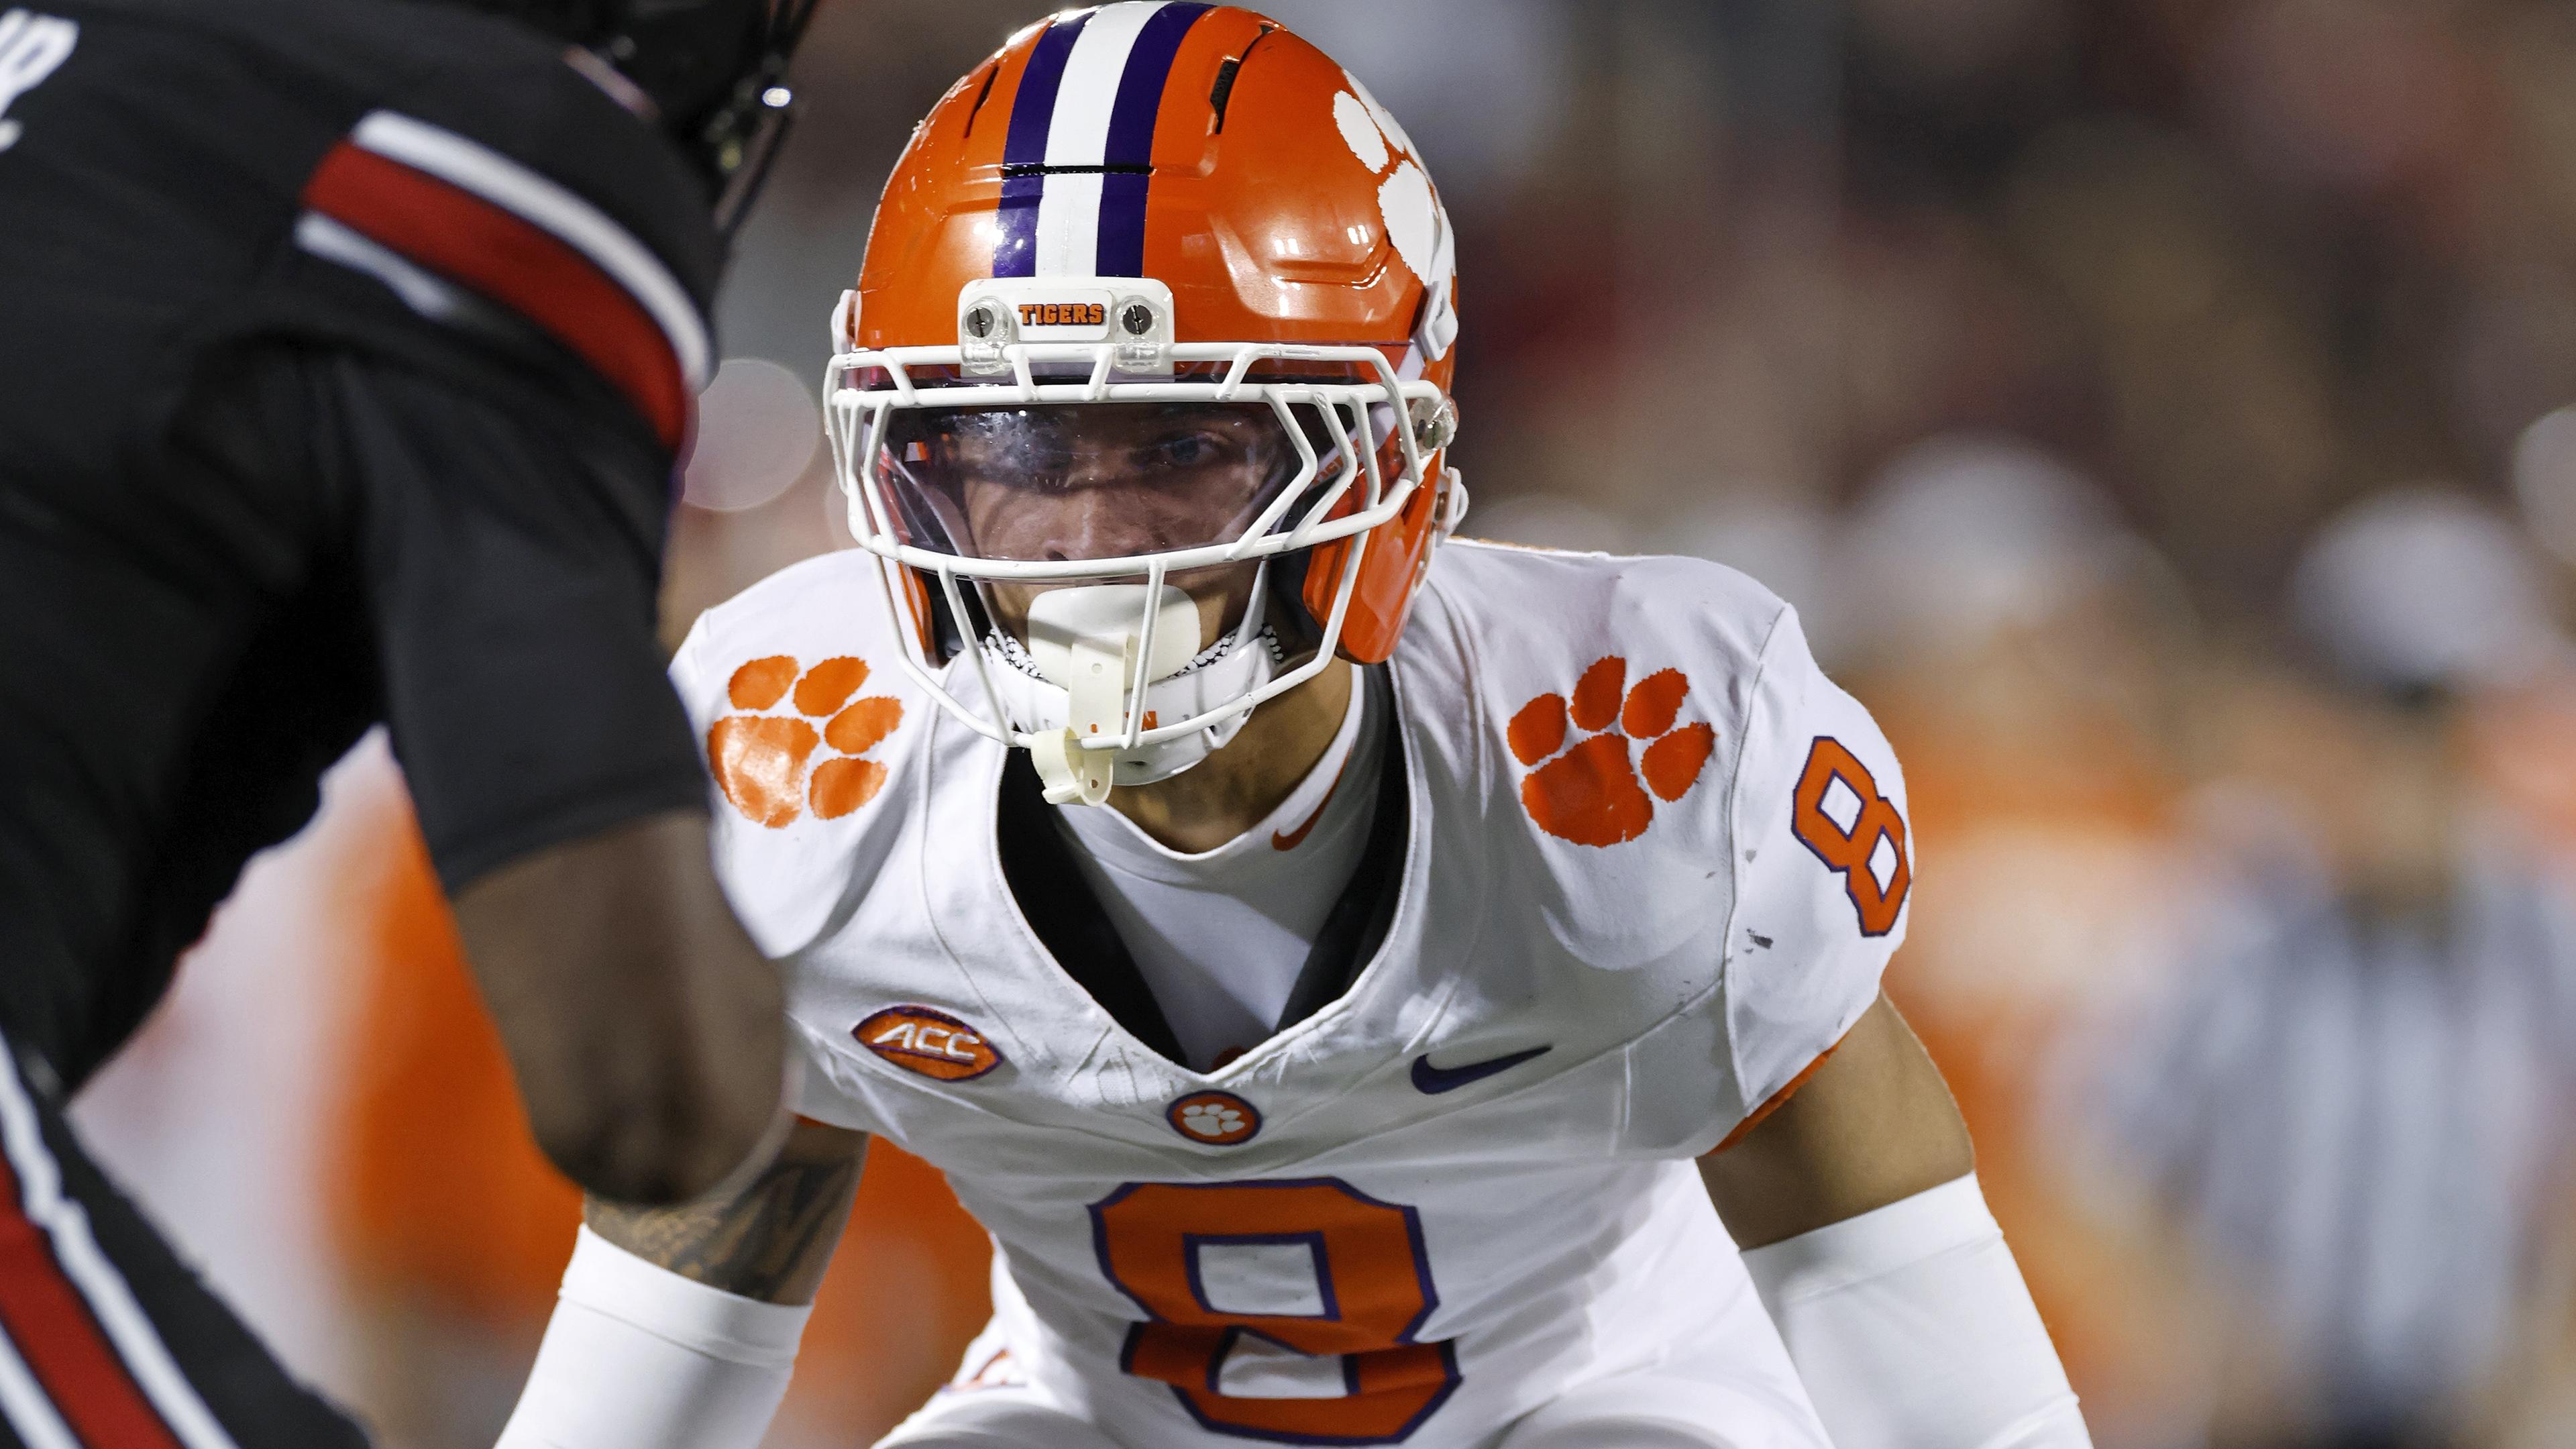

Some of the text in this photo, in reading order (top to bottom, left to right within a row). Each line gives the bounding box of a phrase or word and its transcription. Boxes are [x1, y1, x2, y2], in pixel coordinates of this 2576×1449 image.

[1018, 304, 1106, 327] TIGERS
[1791, 736, 1911, 937] 8
[873, 1022, 980, 1060] ACC
[1086, 1176, 1463, 1446] 8
